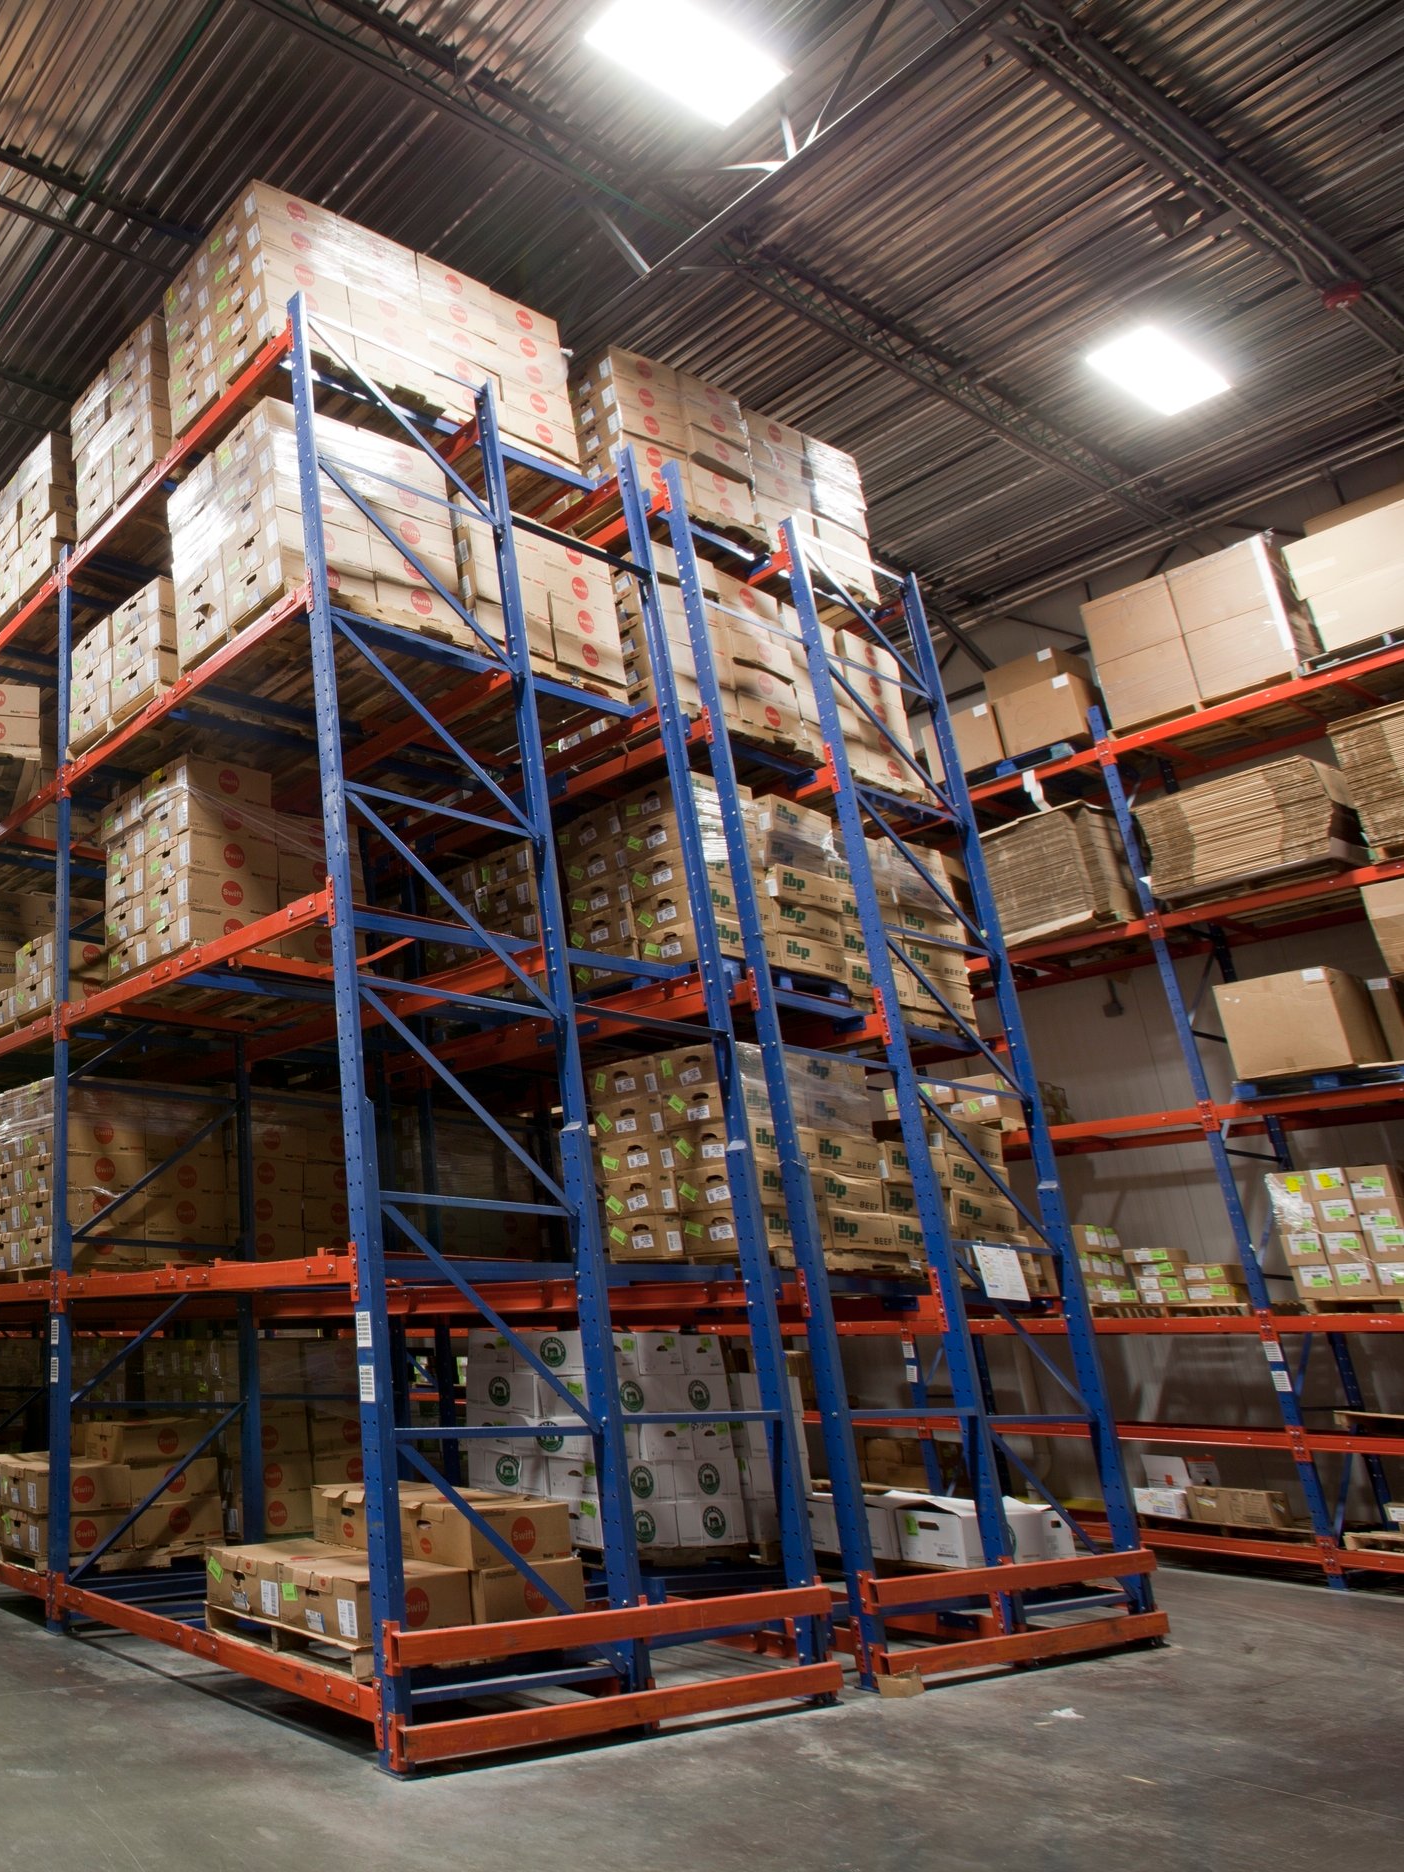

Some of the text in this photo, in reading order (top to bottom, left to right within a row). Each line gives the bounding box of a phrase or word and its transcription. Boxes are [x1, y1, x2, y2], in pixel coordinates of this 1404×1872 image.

[412, 597, 432, 609] Swift
[225, 850, 244, 861] Swift
[783, 872, 805, 891] ibp
[223, 888, 243, 898] Swift
[820, 894, 838, 904] BEEF
[780, 904, 806, 923] ibp
[904, 912, 925, 931] ibp
[820, 927, 839, 938] BEEF
[787, 940, 810, 960] ibp
[909, 946, 930, 965] ibp
[825, 963, 843, 973] BEEF
[945, 967, 964, 976] BEEF
[819, 1138, 842, 1159] ibp
[96, 1166, 115, 1174] Swift
[857, 1161, 877, 1170] BEEF
[954, 1163, 975, 1184] ibp
[824, 1177, 847, 1198] ibp
[859, 1201, 879, 1211] BEEF
[959, 1198, 982, 1220] ibp
[834, 1216, 858, 1237] ibp
[899, 1224, 923, 1245] ibp
[874, 1237, 893, 1246] BEEF
[73, 1485, 94, 1495] Swift
[269, 1510, 286, 1519] Swift
[76, 1530, 96, 1539] Swift
[513, 1530, 536, 1540] Swift
